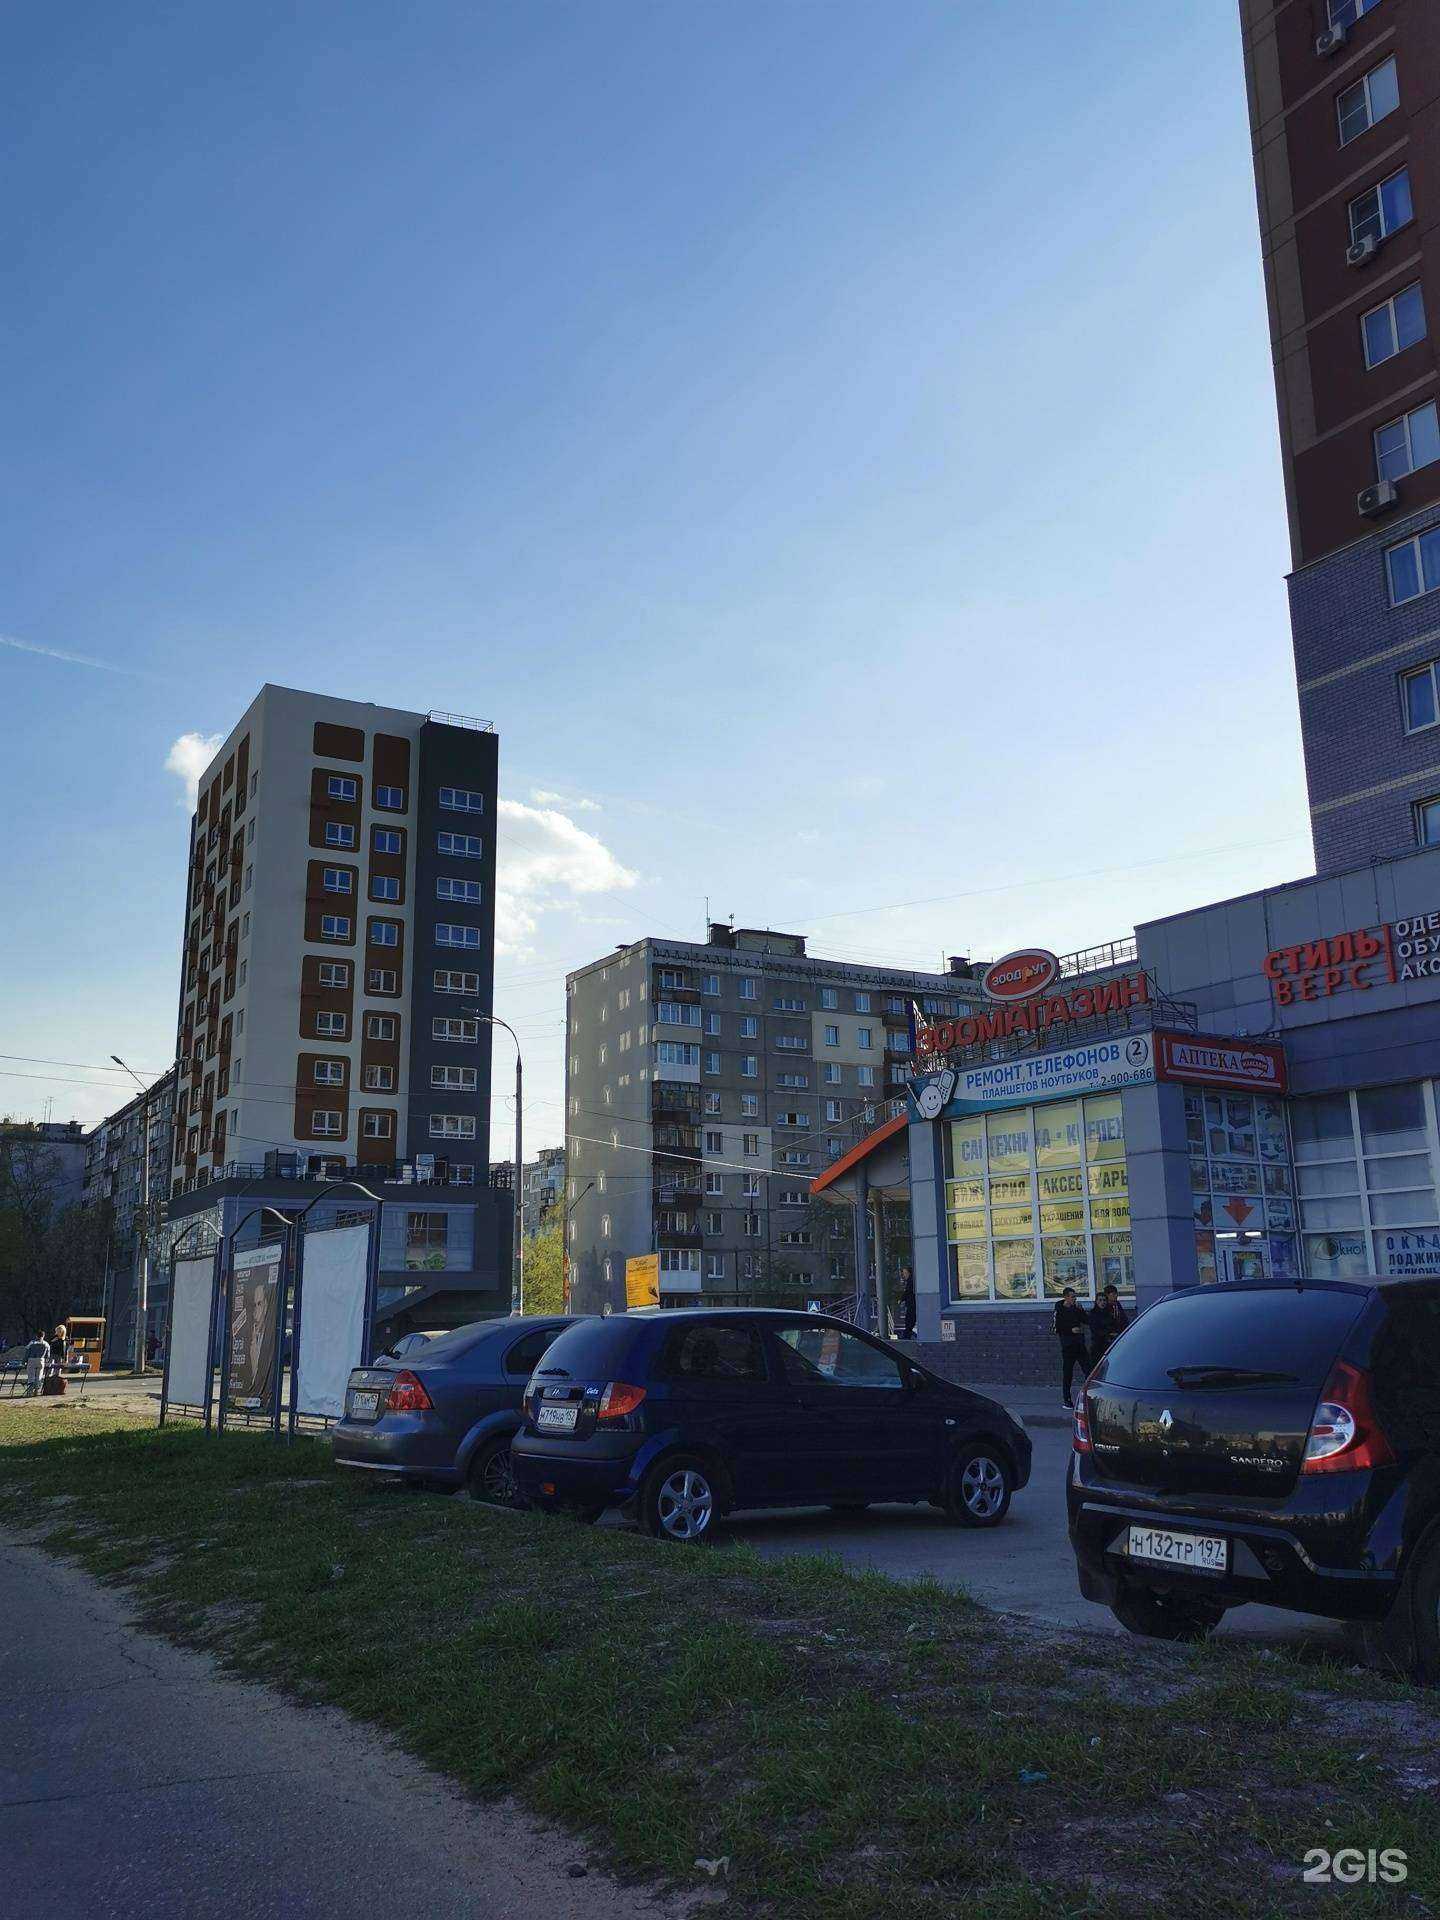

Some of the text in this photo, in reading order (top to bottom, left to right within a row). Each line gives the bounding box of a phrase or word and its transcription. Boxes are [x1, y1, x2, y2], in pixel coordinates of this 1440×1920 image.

[1264, 929, 1380, 978] СТИЛЬ
[1276, 963, 1371, 1006] ВЕРС
[916, 972, 1149, 1055] ЗООМАГАЗИН
[966, 1044, 1120, 1089] РЕМОНТ ТЕЛЕФОНОВ
[1178, 1047, 1239, 1070] АПТЕКА
[982, 1068, 1099, 1100] ПЛАНШЕТОВ НОУТБУКОВ
[1101, 1067, 1152, 1087] 2-900-686
[1230, 1455, 1283, 1466] SANDERO
[1198, 1538, 1222, 1558] 197
